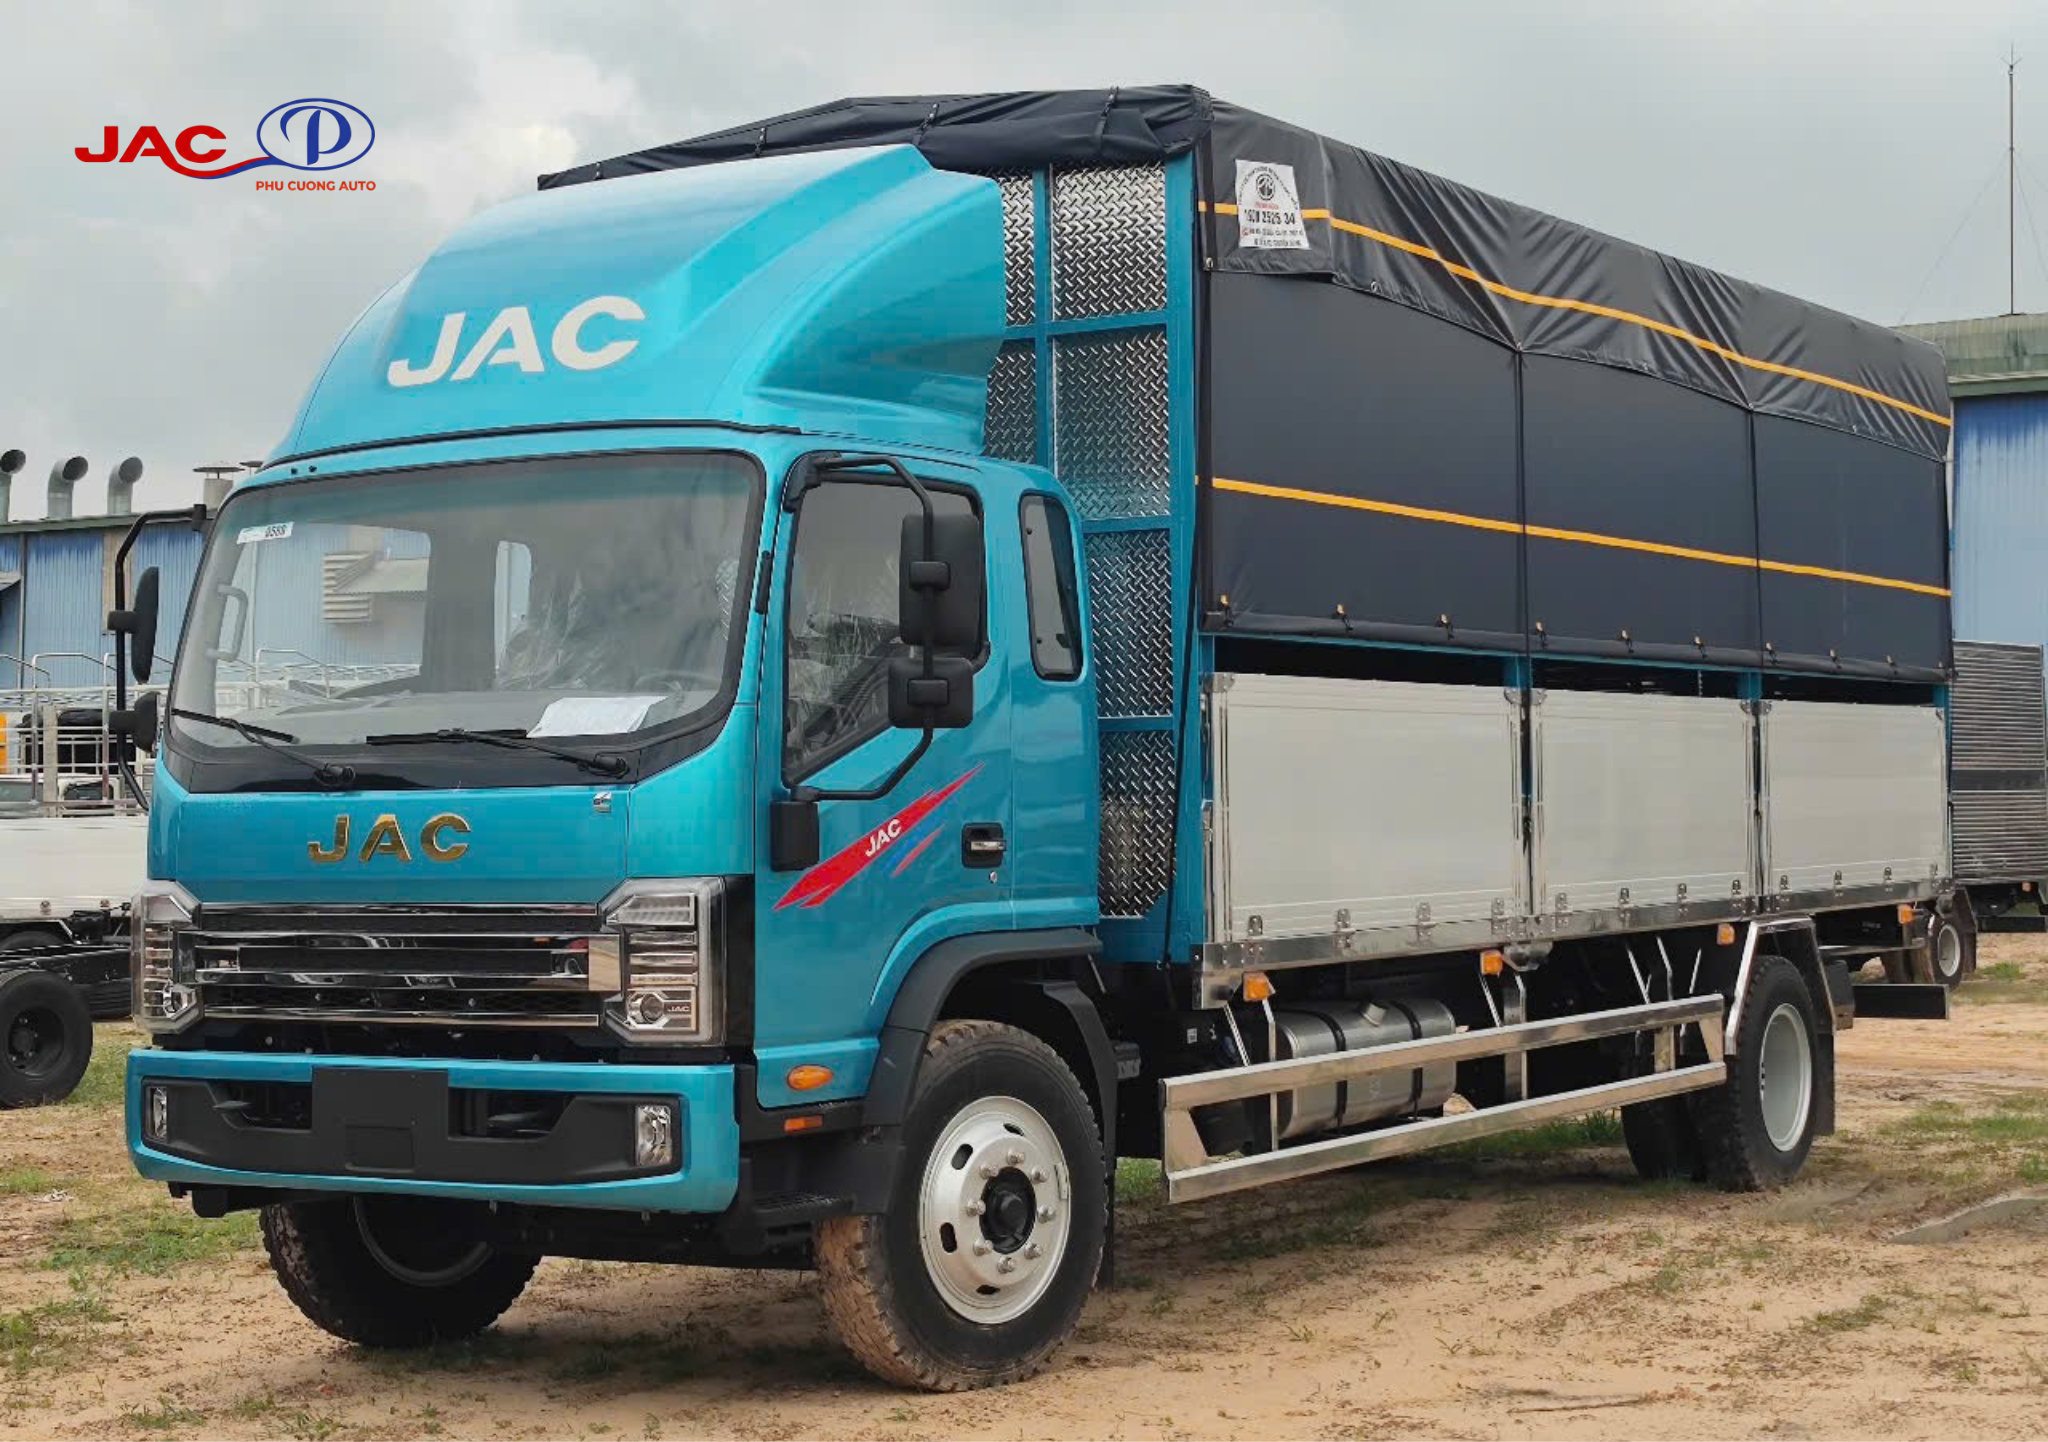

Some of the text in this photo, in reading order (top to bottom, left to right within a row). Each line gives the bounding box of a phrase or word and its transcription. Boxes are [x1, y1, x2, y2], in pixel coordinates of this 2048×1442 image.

[387, 295, 646, 387] JAC
[307, 813, 471, 862] JAC
[865, 818, 902, 857] JAC
